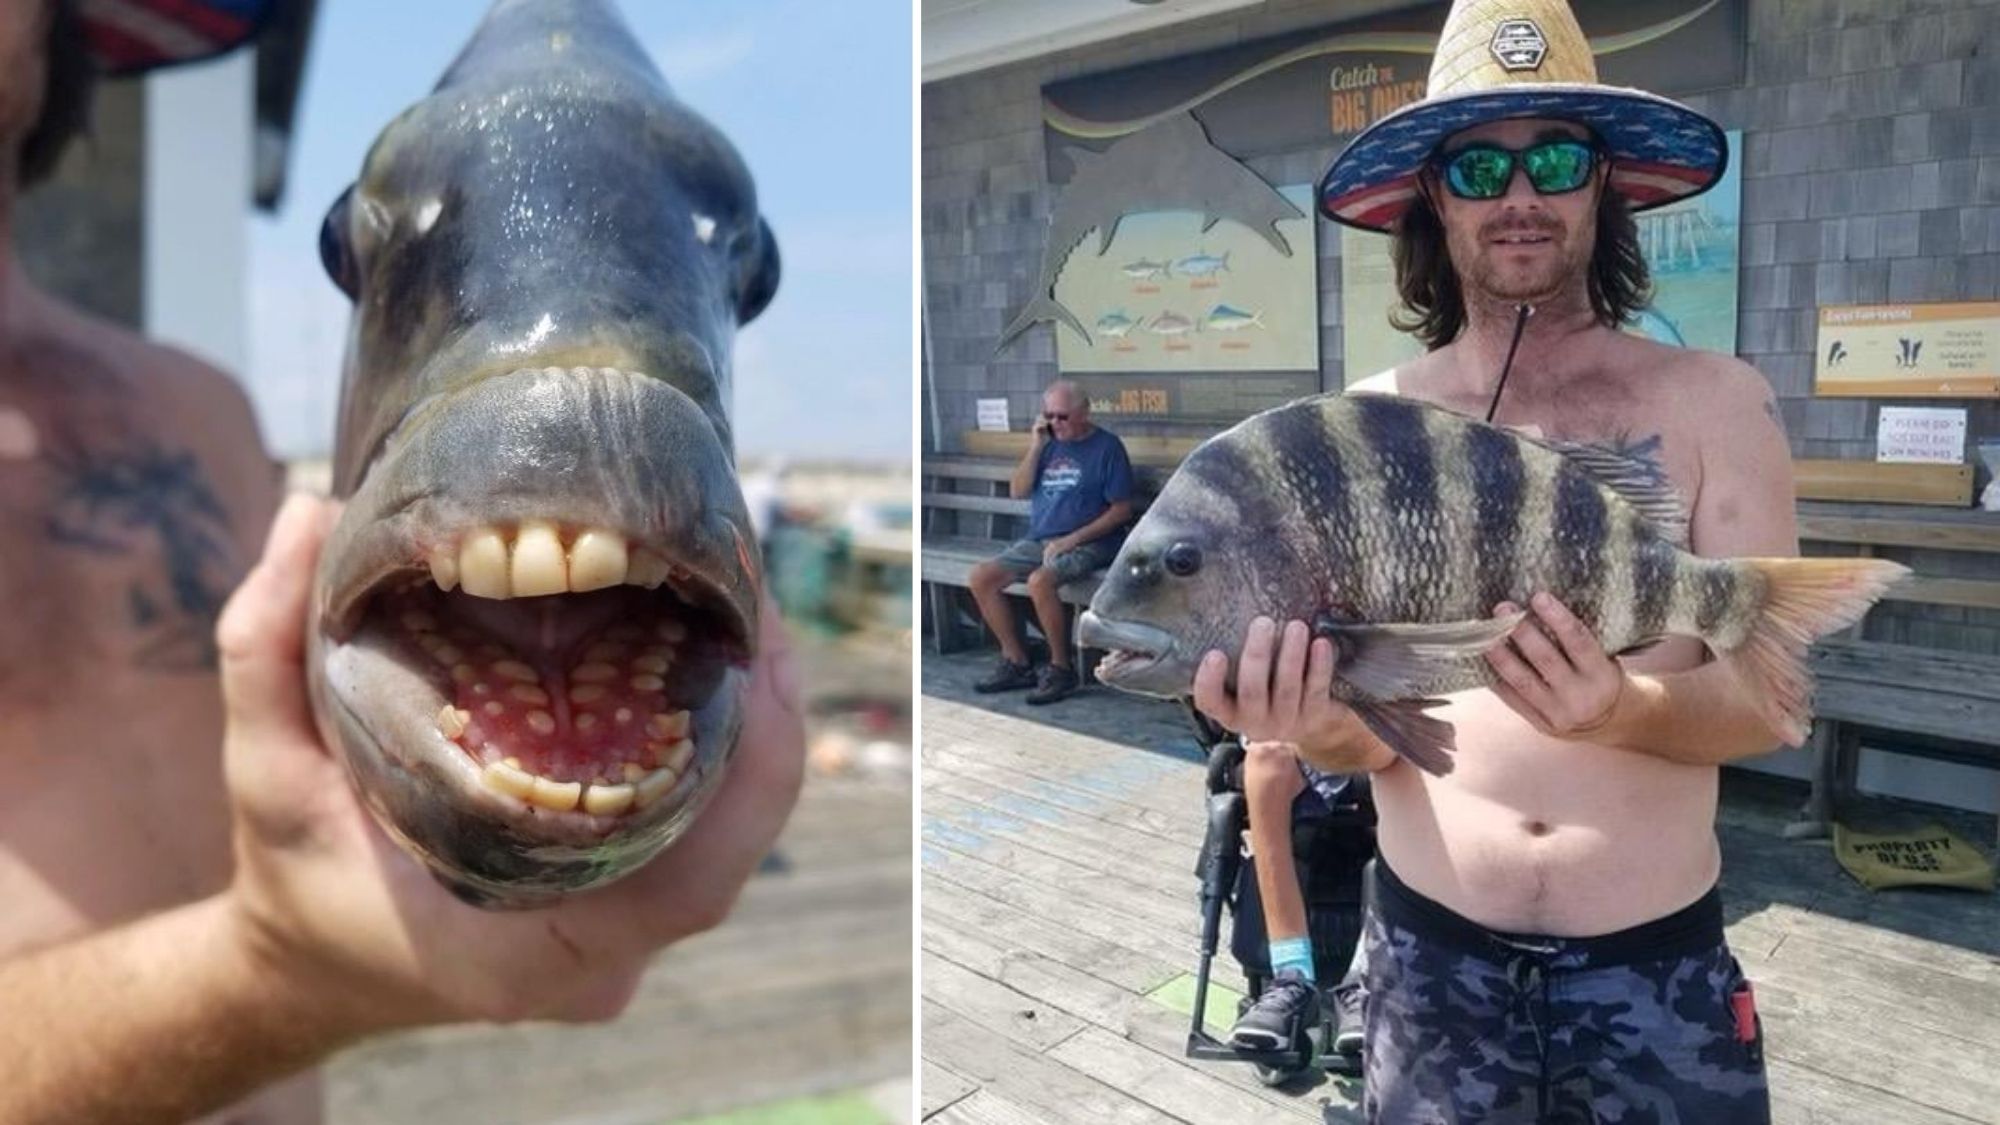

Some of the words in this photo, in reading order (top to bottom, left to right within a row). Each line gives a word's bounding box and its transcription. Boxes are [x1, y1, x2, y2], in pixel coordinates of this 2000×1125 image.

[1330, 64, 1377, 91] Catch
[1331, 91, 1366, 134] BIG
[1852, 838, 1951, 854] PROPERTY
[1876, 851, 1898, 864] OF
